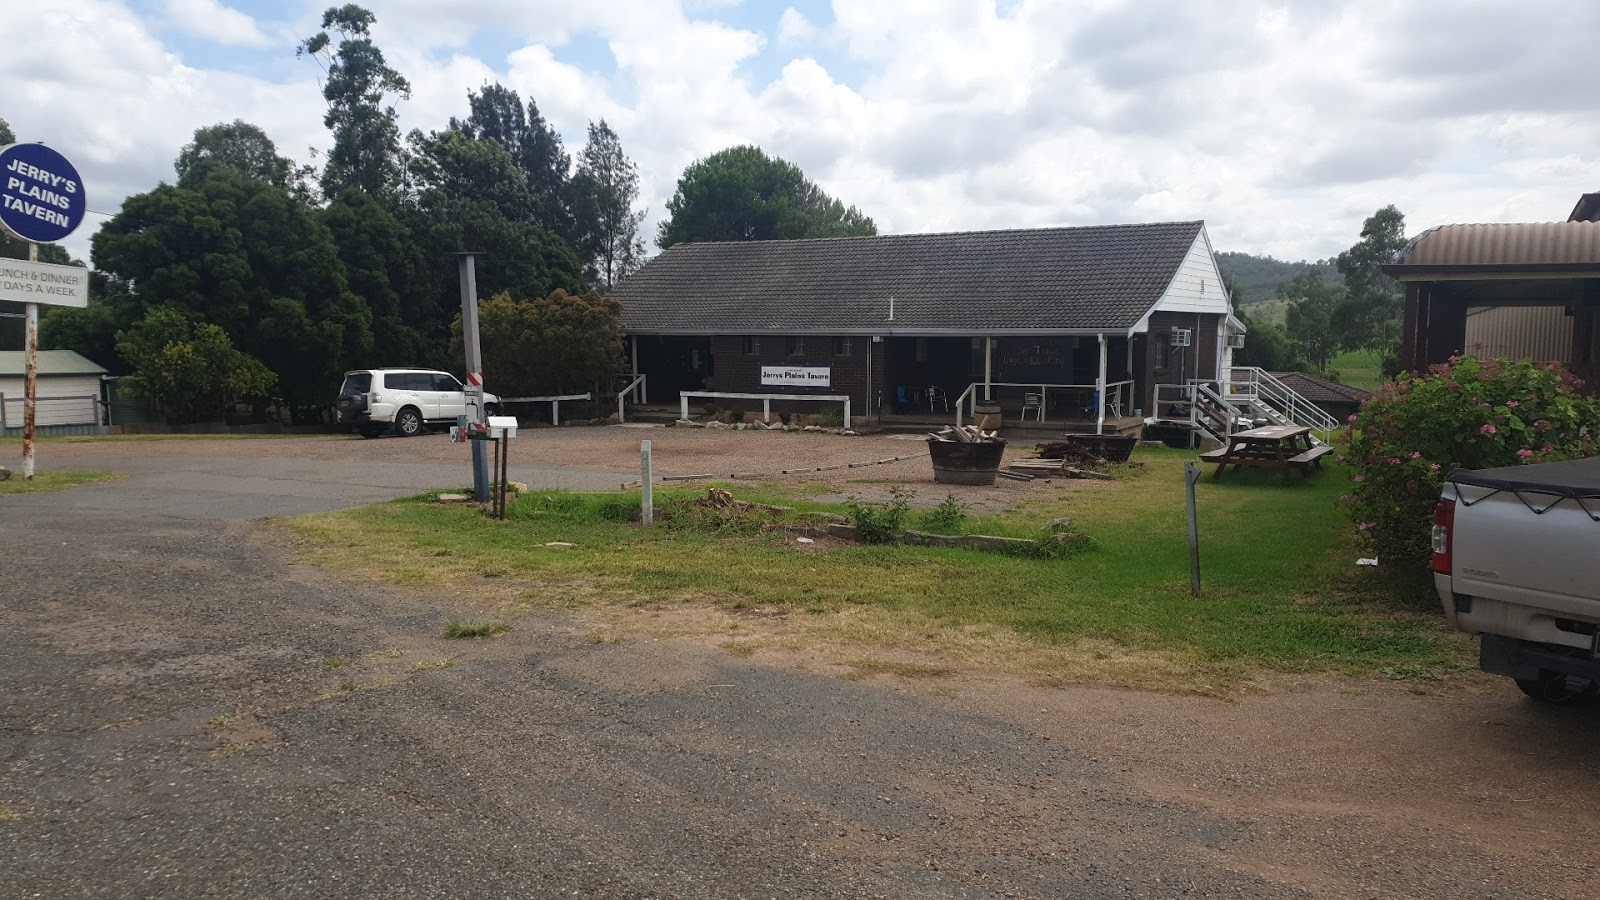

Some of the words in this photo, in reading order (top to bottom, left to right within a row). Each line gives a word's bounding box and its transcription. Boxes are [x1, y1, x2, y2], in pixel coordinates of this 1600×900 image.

[7, 159, 77, 193] JERRY'S
[8, 177, 70, 209] PLAINS
[3, 194, 69, 228] TAVERN
[4, 281, 32, 292] DAYS
[35, 285, 43, 293] A
[46, 286, 75, 296] WEEK
[31, 272, 37, 280] &
[40, 273, 79, 285] DINNER
[762, 371, 783, 379] Jerrys
[784, 371, 806, 379] Plains
[807, 372, 829, 380] Tavern
